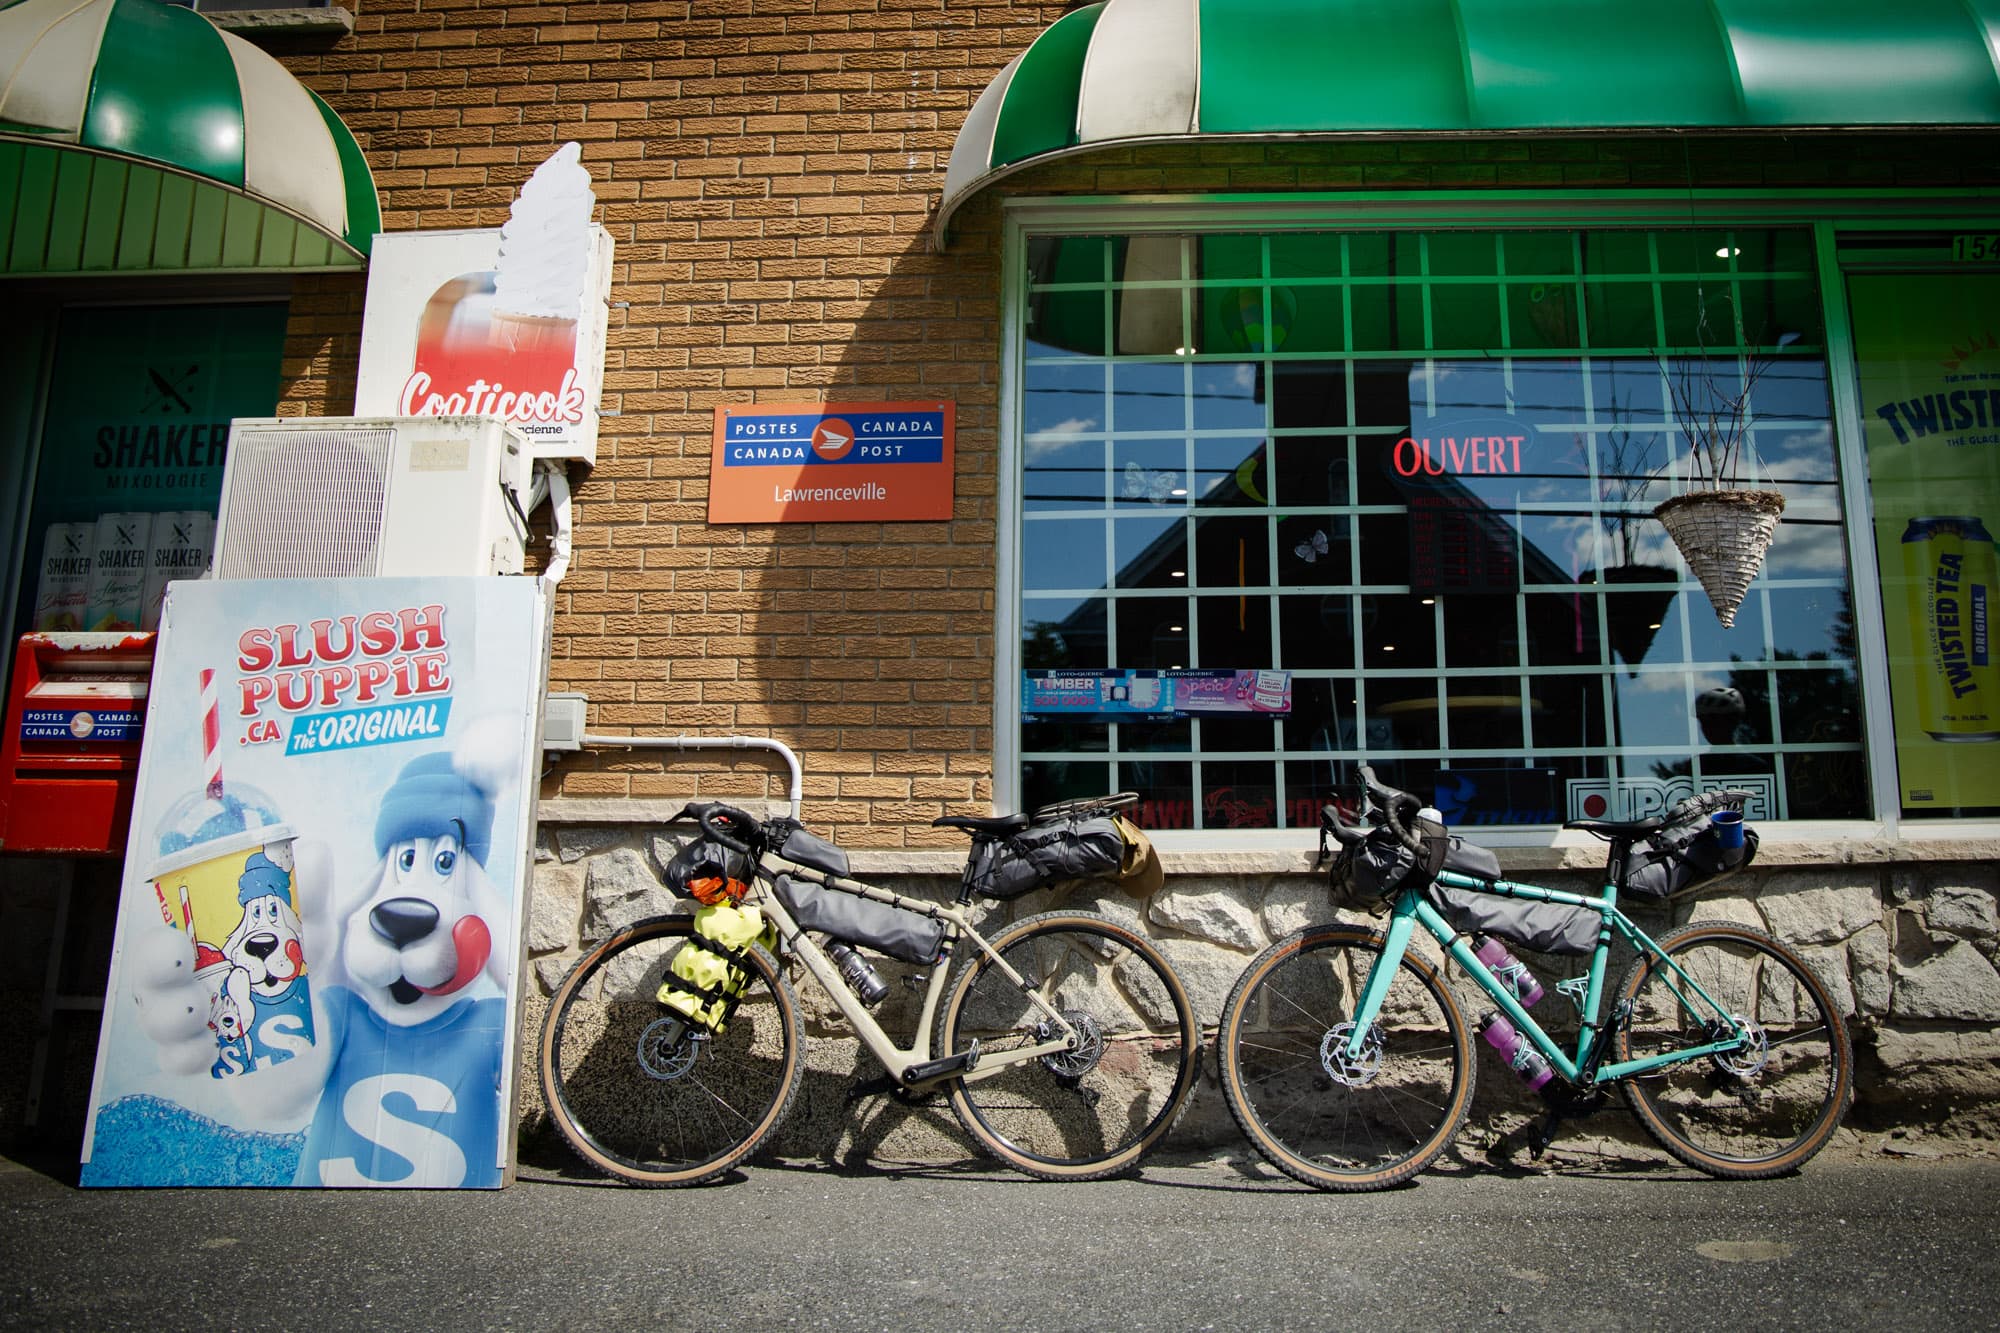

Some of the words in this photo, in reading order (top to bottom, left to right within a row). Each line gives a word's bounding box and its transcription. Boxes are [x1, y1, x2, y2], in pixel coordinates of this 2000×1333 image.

[400, 367, 584, 423] Coaticook
[735, 422, 798, 435] POSTES
[861, 420, 934, 433] CANADA
[94, 424, 229, 468] SHAKER
[733, 446, 805, 460] CANADA
[860, 445, 904, 457] POST
[1393, 436, 1525, 477] OUVERT
[774, 483, 886, 502] Lawrenceville
[47, 557, 91, 576] SHAKER
[98, 549, 145, 568] SHAKER
[155, 548, 202, 567] SHAKER
[1936, 553, 1964, 594] TEA
[1974, 595, 1986, 654] ORIGINAL
[238, 604, 447, 673] SLUSH
[1936, 598, 1977, 699] TWISTED
[27, 713, 65, 721] POSTES
[97, 713, 139, 722] CANADA
[25, 728, 66, 736] CANADA
[96, 728, 122, 737] POST
[240, 719, 281, 745] .CA
[293, 734, 316, 751] The
[319, 1073, 468, 1188] S
